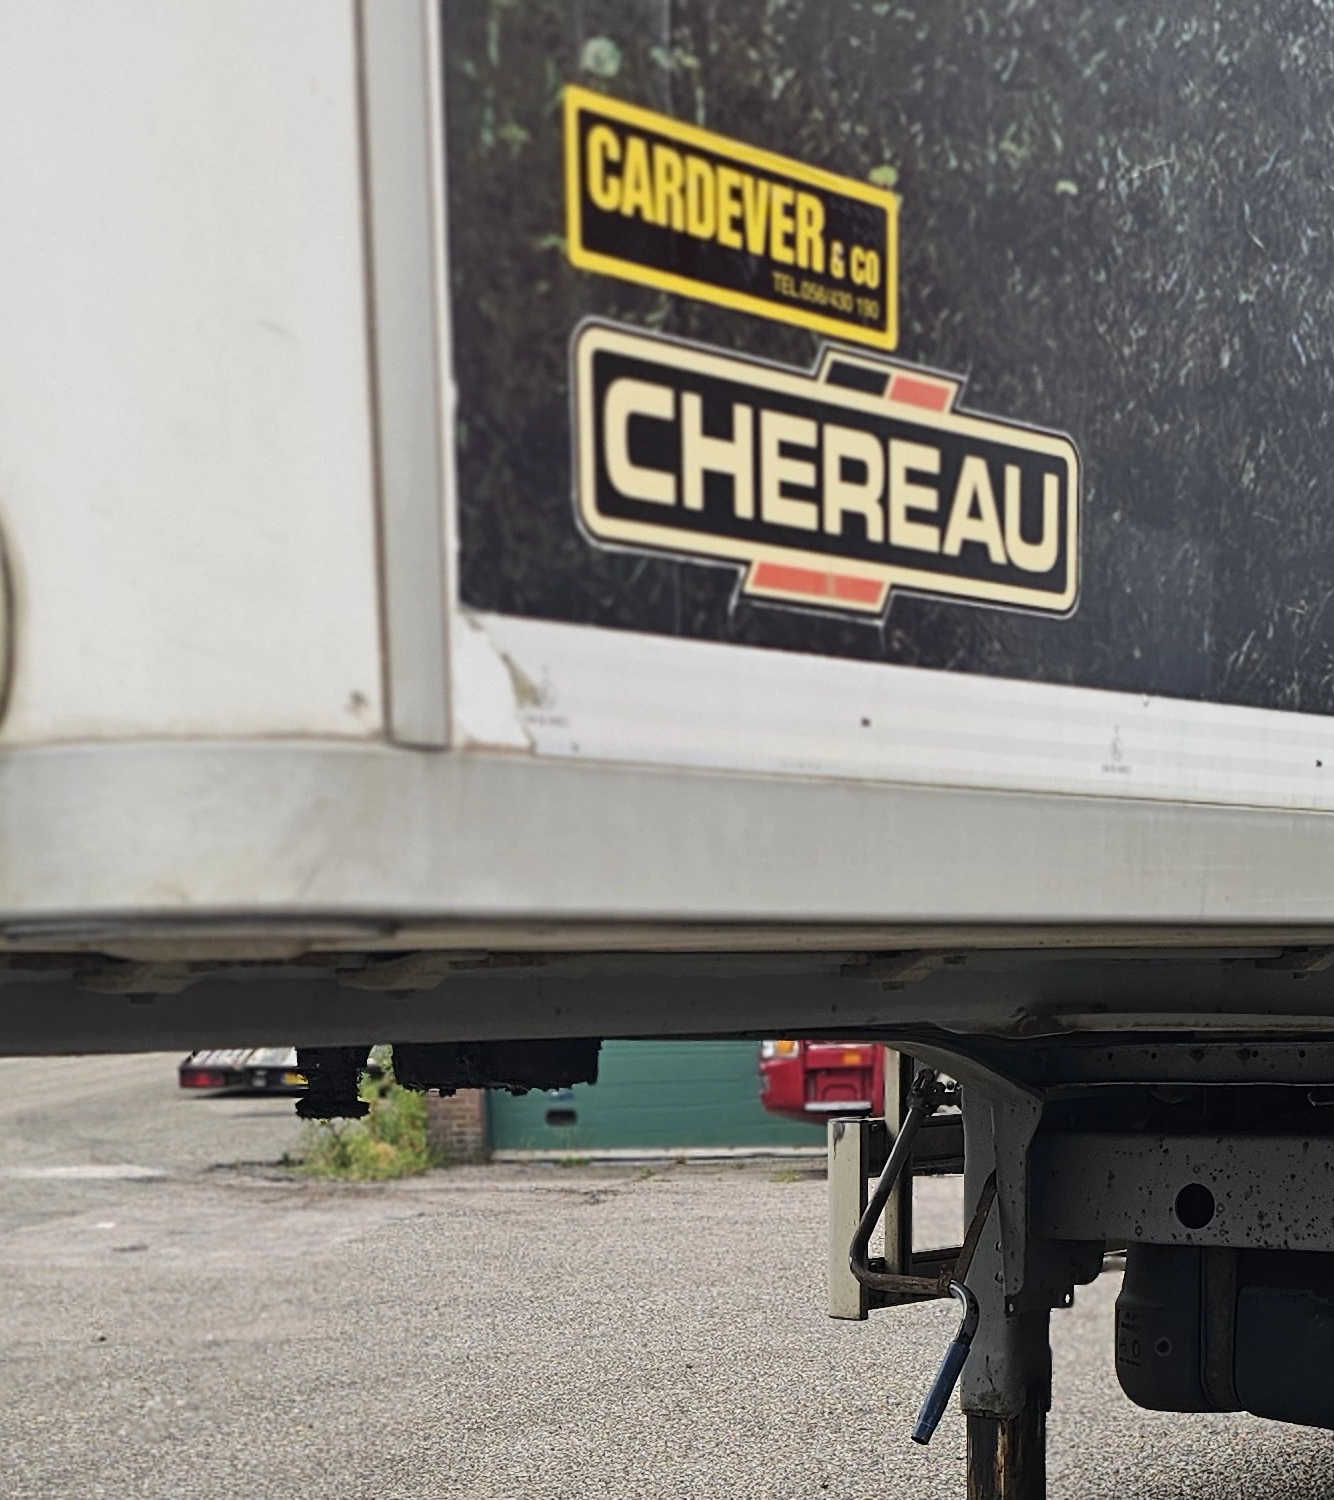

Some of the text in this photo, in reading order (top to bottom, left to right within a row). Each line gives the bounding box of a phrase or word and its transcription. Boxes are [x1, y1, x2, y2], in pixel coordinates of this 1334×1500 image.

[587, 125, 880, 289] CARDEVER & CO
[604, 377, 1059, 572] CHEREAU
